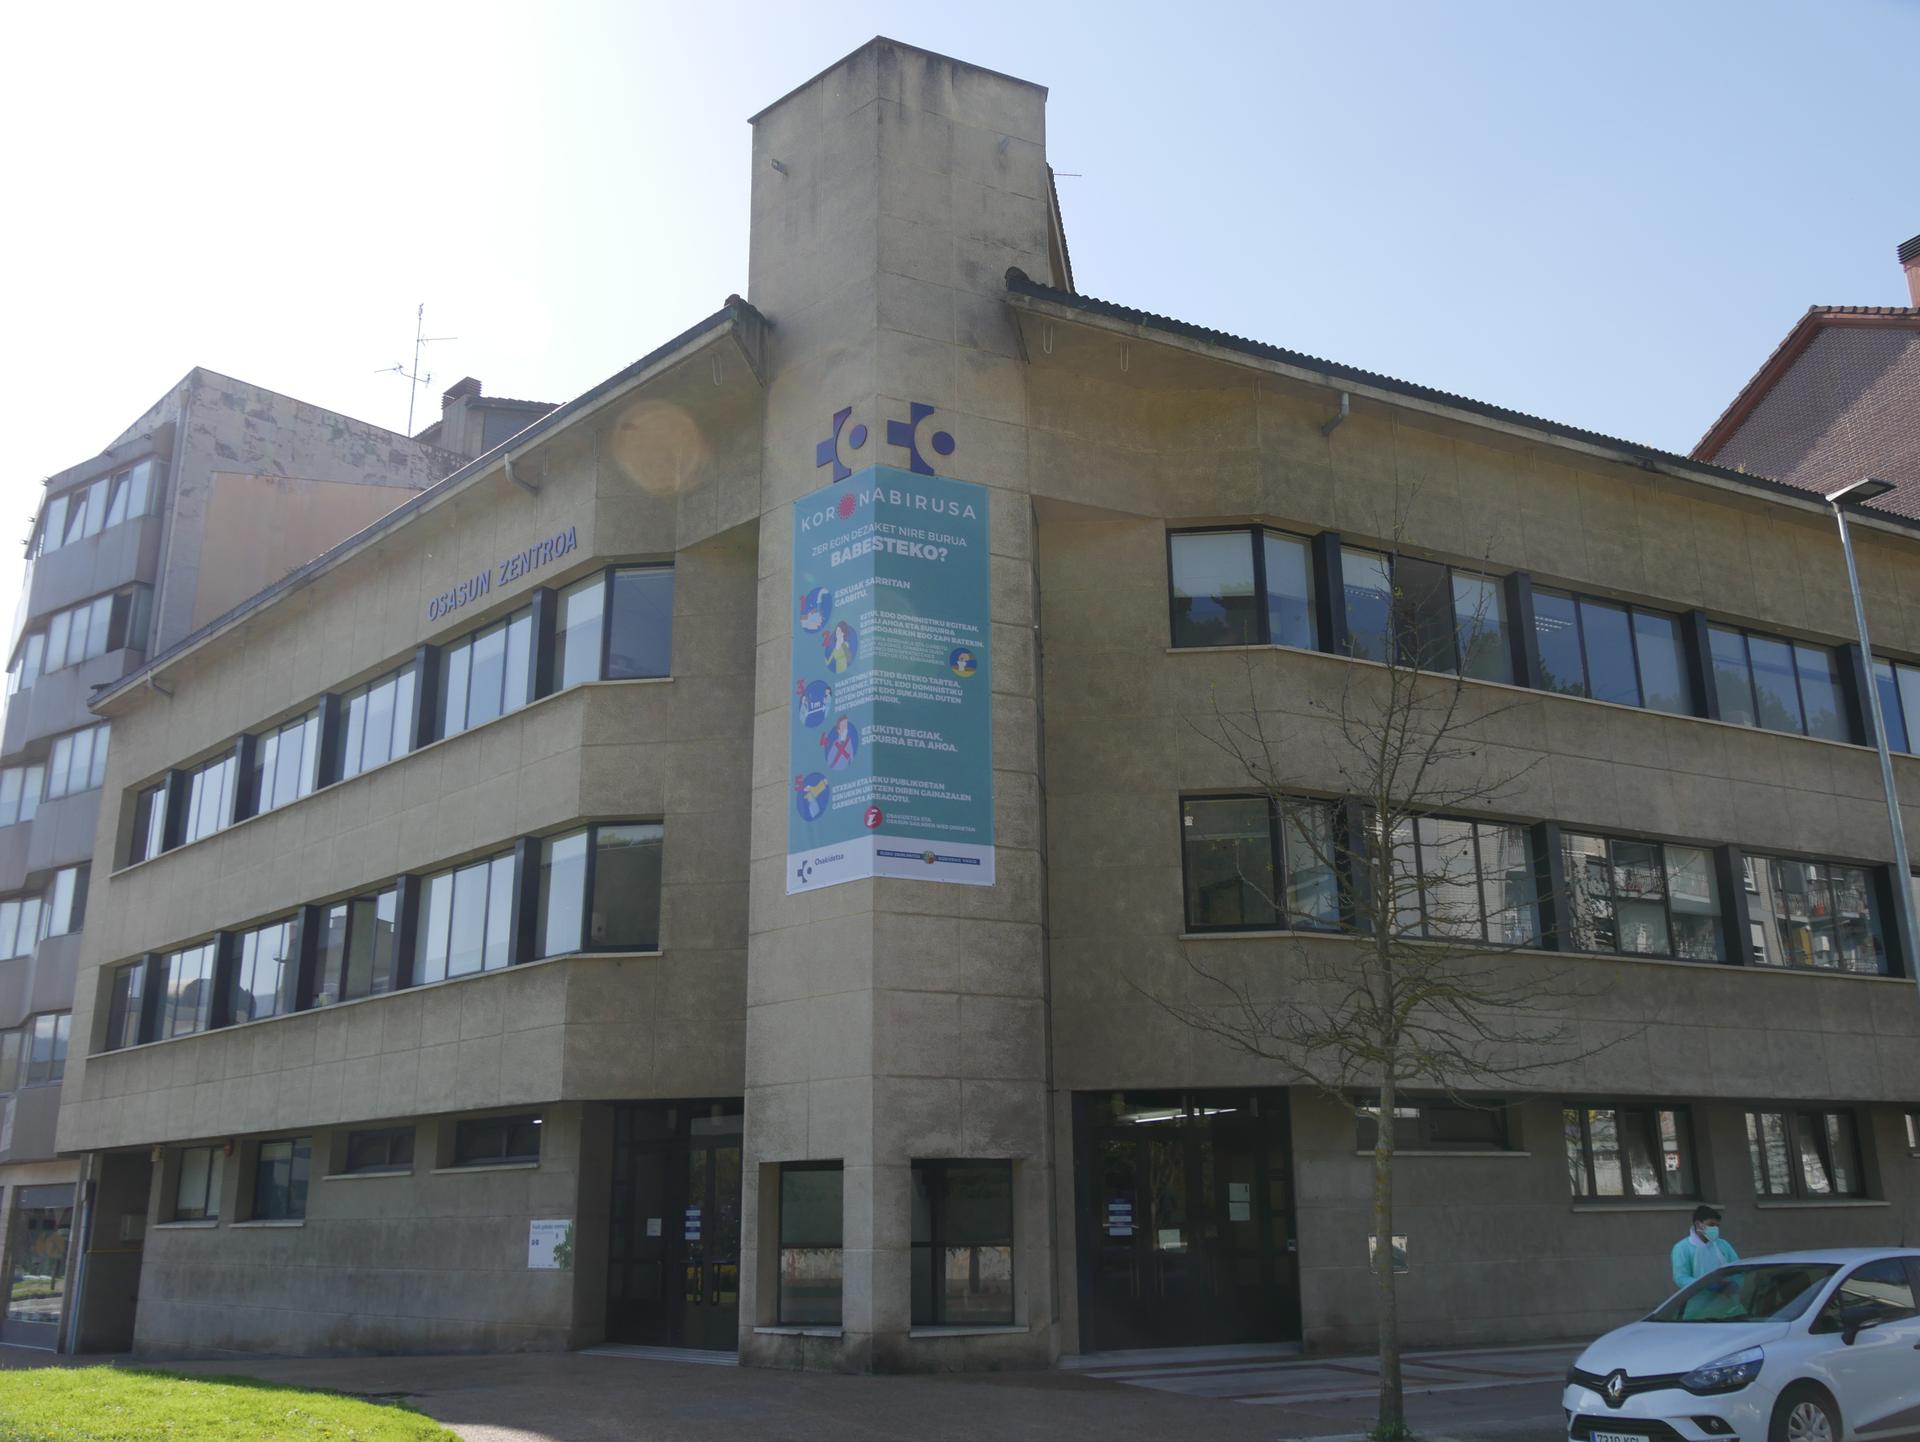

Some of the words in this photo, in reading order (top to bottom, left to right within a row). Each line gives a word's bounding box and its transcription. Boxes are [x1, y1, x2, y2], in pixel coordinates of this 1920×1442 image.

[811, 543, 828, 557] ZER
[830, 533, 850, 550] EGIN
[851, 522, 897, 540] DEZAKET
[898, 526, 926, 540] NIRE
[927, 531, 968, 548] BURUA
[831, 535, 948, 568] BABESTEKO?
[428, 569, 492, 622] OSASUN
[498, 526, 578, 587] ZENTROA
[872, 725, 903, 736] UKITU
[906, 738, 926, 749] ETA
